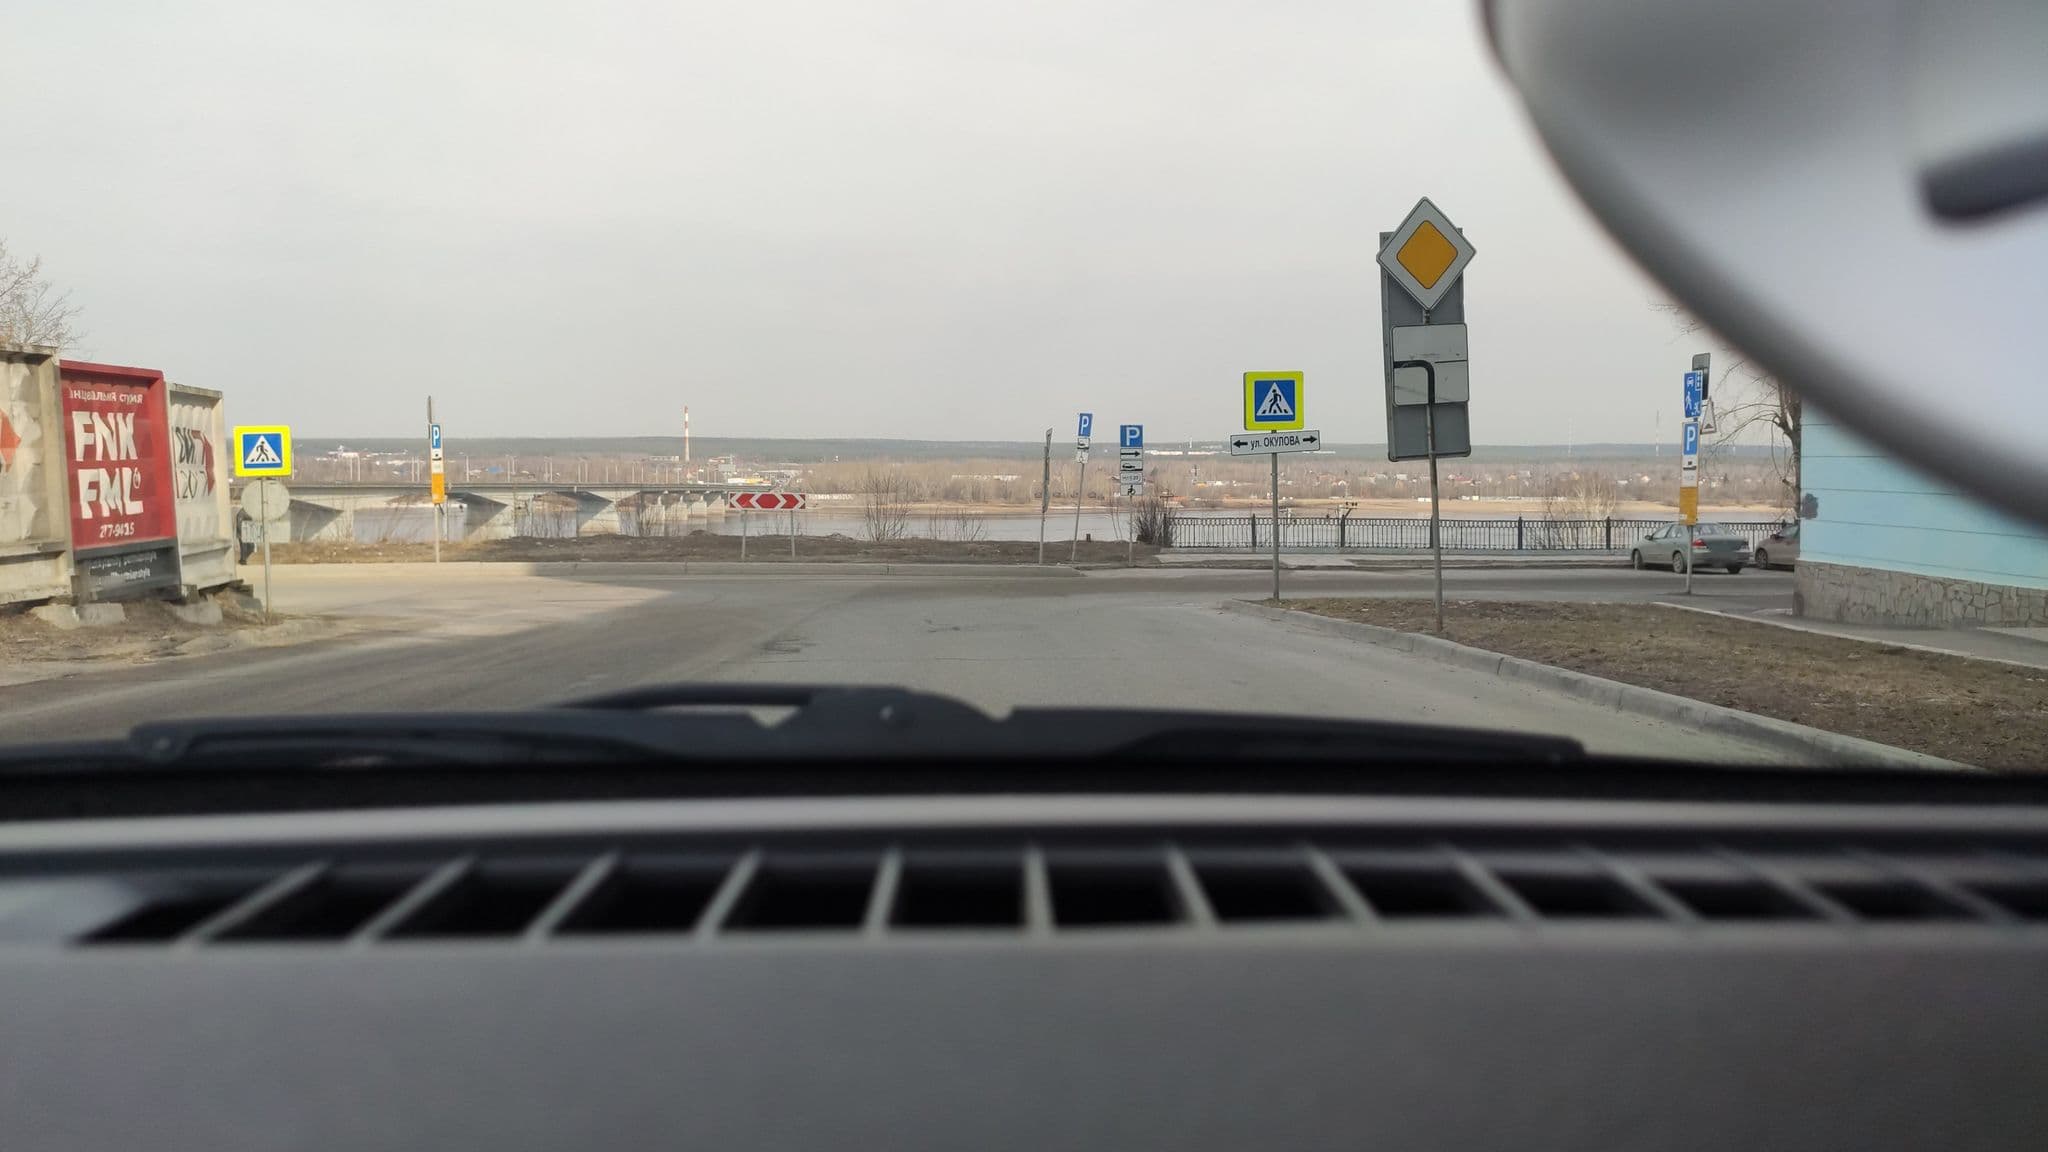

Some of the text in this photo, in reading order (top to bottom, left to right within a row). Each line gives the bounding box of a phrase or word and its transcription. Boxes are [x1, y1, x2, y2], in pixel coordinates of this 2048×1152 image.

[1080, 415, 1089, 435] P
[72, 411, 138, 462] FNK
[433, 426, 440, 447] P
[1126, 427, 1140, 446] P
[1251, 436, 1300, 450] ул. ОКУЛОВА
[1686, 426, 1696, 452] P
[78, 467, 144, 519] FML
